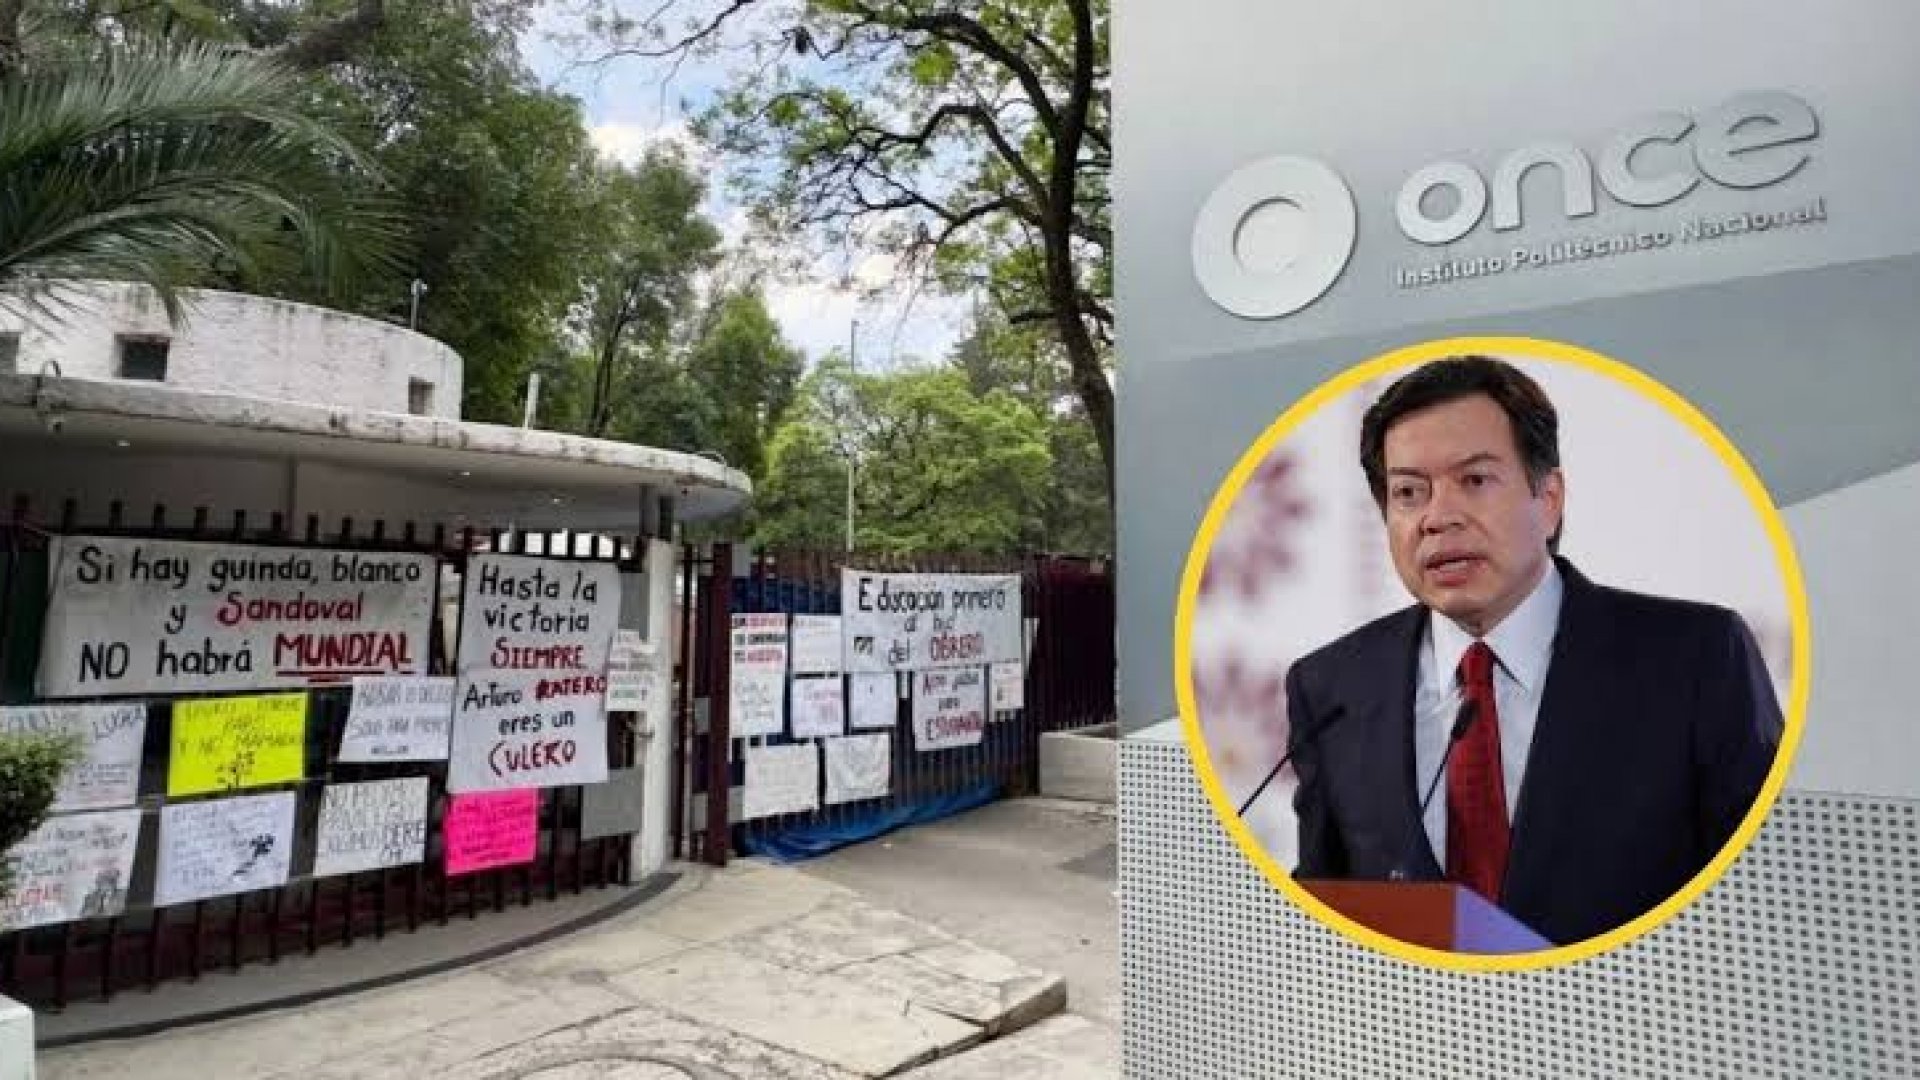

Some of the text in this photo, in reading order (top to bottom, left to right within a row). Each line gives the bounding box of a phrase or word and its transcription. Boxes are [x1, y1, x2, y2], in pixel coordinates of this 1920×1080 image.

[1395, 89, 1821, 247] once
[1396, 196, 1828, 288] Instituto Politécnico Nacional
[77, 545, 421, 593] Si hay guinda, blanco
[479, 562, 599, 603] Hasta la
[164, 591, 364, 635] y Sandoval
[483, 602, 590, 633] victoria
[79, 632, 412, 683] NO habrá MUNDIAL
[888, 637, 911, 666] del
[498, 710, 576, 736] eres un
